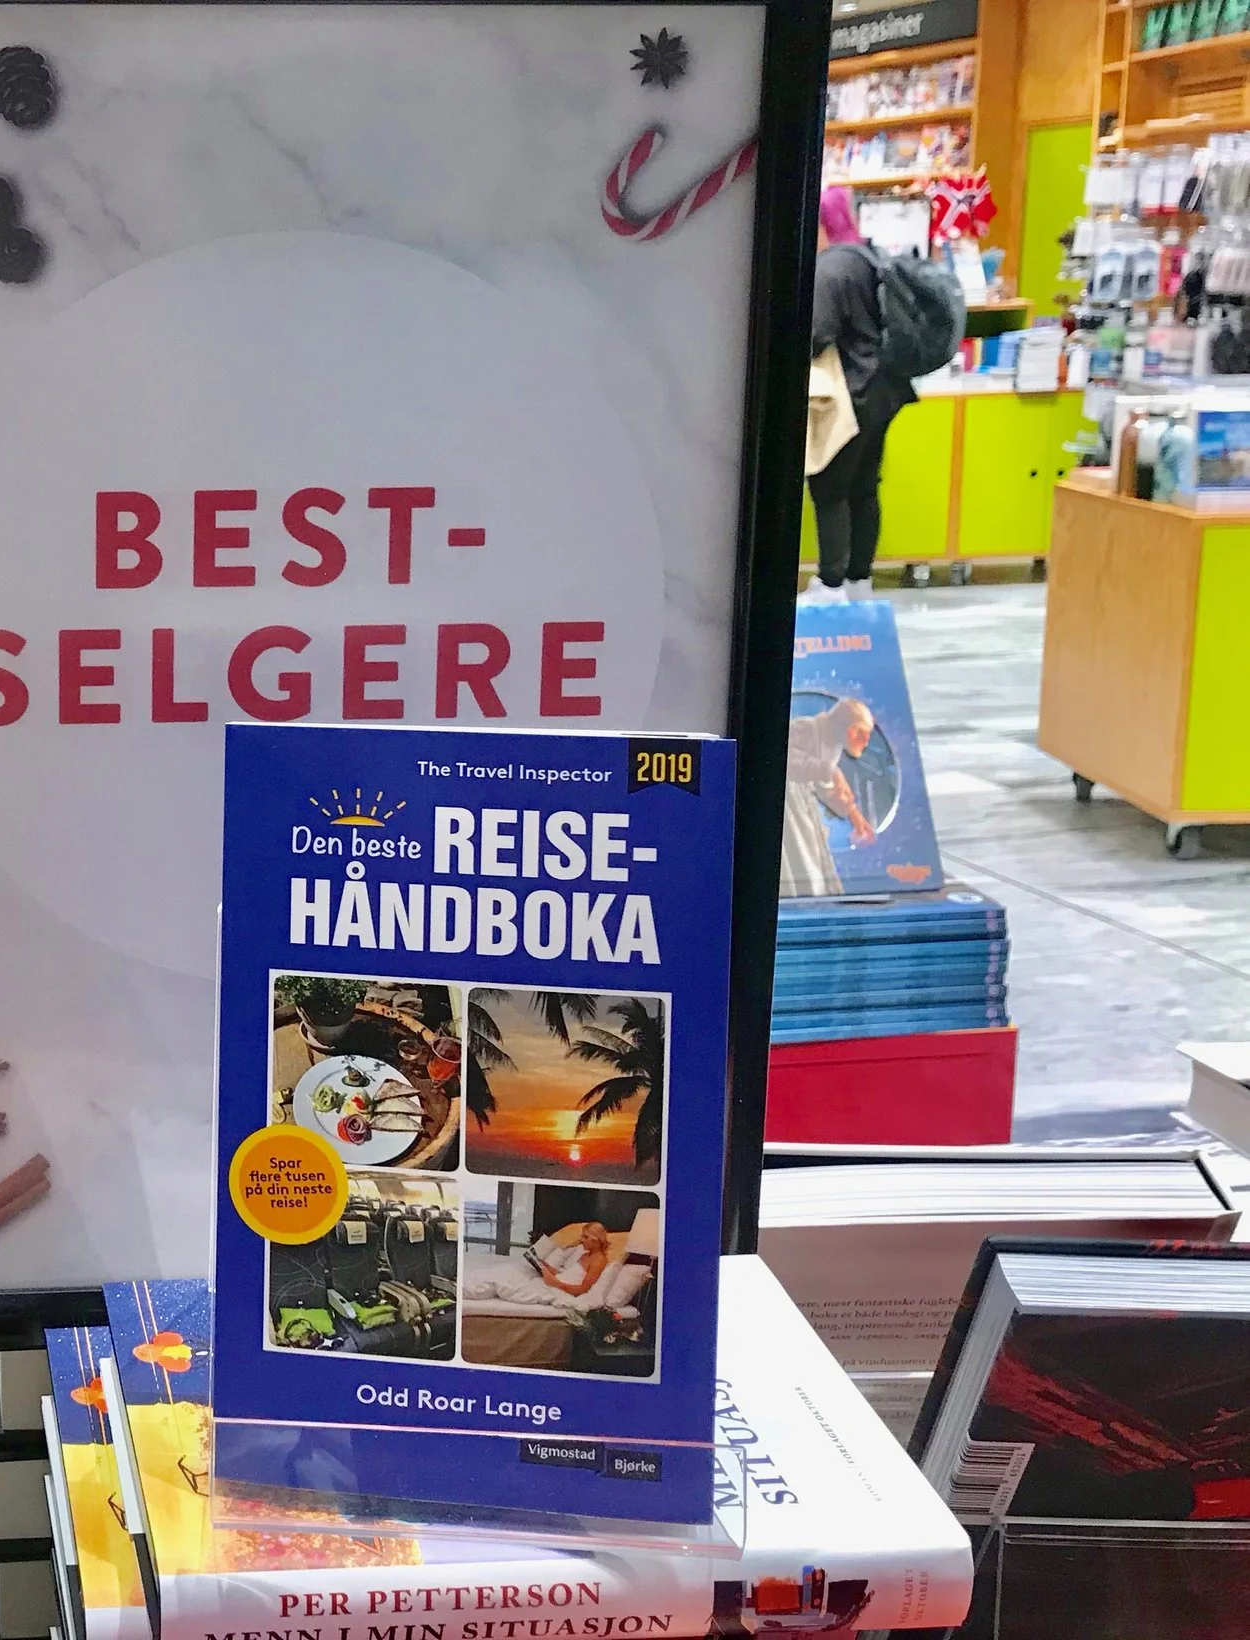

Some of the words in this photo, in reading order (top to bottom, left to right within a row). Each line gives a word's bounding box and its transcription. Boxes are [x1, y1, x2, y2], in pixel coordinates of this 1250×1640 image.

[831, 12, 924, 53] magasiner
[95, 486, 486, 589] BEST-
[417, 760, 451, 777] The
[455, 761, 513, 780] Travel
[518, 764, 612, 785] Inspector
[636, 752, 692, 784] 2019
[291, 825, 343, 856] Den
[352, 827, 422, 859] beste
[433, 805, 658, 882] REISE-
[290, 860, 661, 965] HÅNDBOKA
[249, 1171, 281, 1182] flere
[285, 1171, 325, 1182] tusen
[269, 1157, 302, 1172] Spar
[245, 1183, 262, 1199] på
[267, 1183, 289, 1195] din
[294, 1183, 332, 1195] neste
[270, 1196, 308, 1208] reise!
[356, 1384, 409, 1408] Odd
[418, 1389, 477, 1413] Roar
[485, 1395, 562, 1426] Lange
[794, 1386, 825, 1423] OKTOBER
[527, 1443, 596, 1461] Vigmostad
[614, 1458, 656, 1475] Bjørke
[820, 1420, 856, 1464] FORLAGET
[279, 1592, 351, 1619] PER
[367, 1582, 602, 1615] PETTERSON
[367, 1623, 446, 1640] MIN
[462, 1614, 674, 1640] SITUASJON
